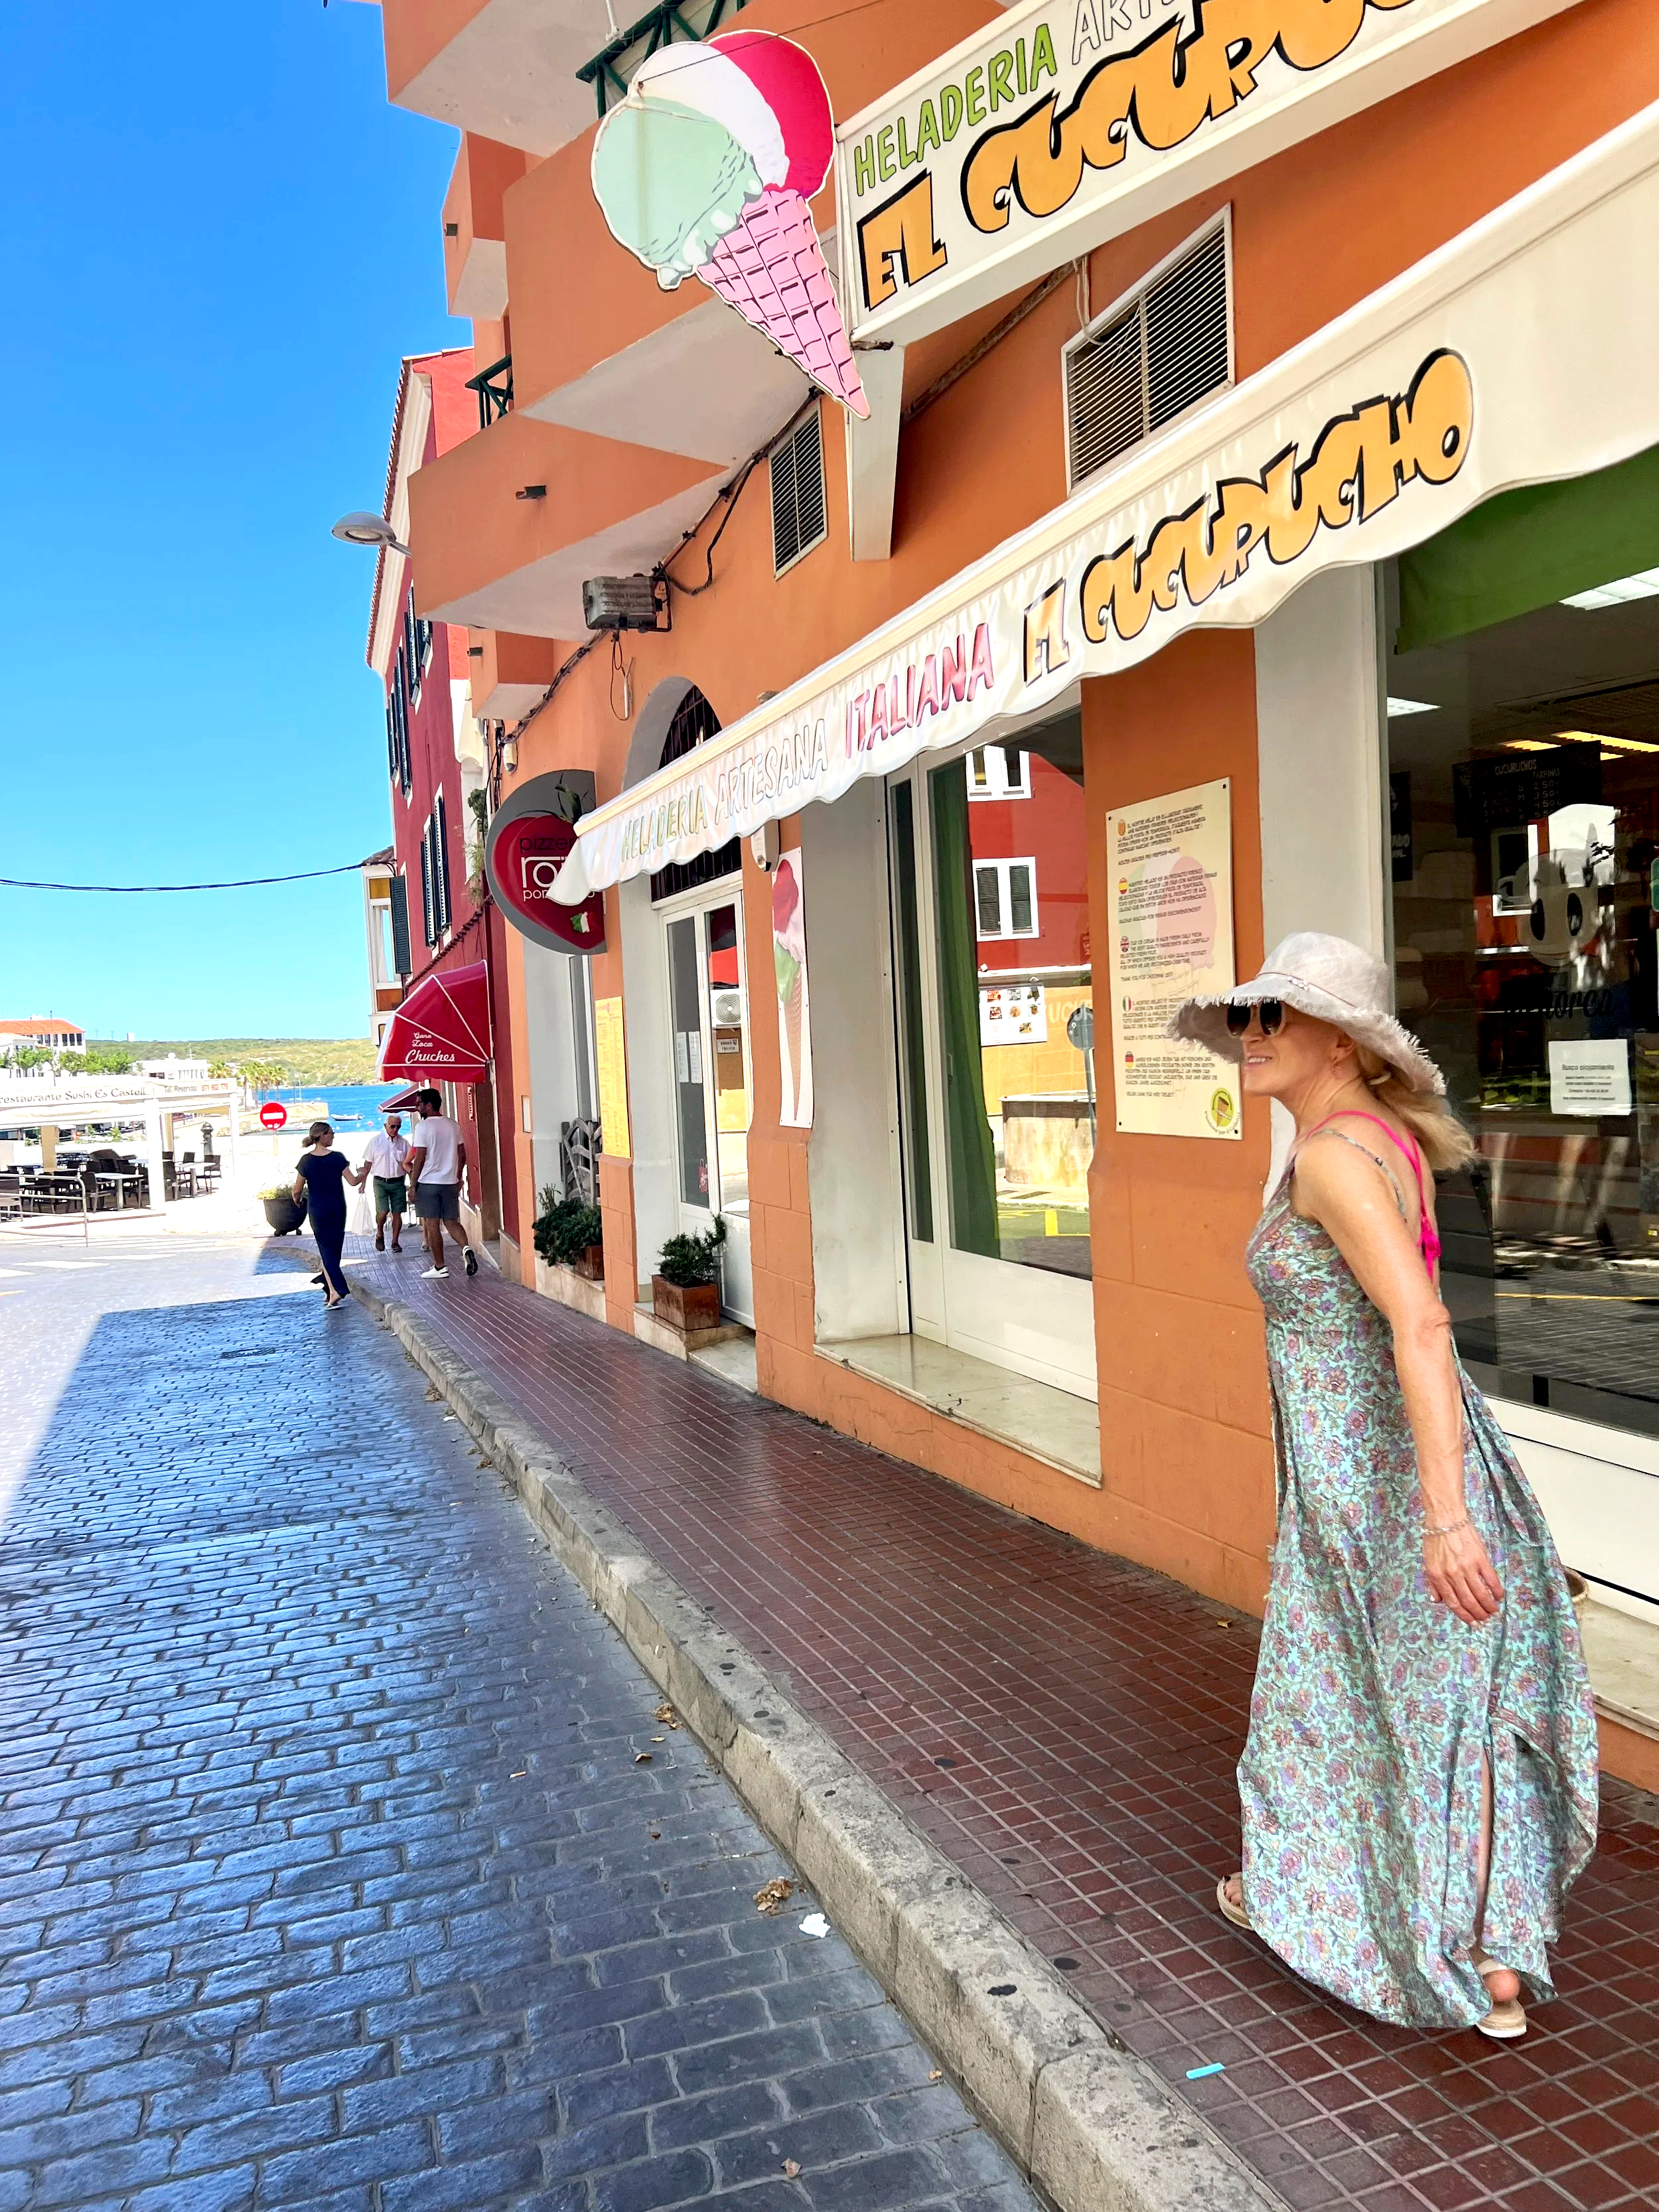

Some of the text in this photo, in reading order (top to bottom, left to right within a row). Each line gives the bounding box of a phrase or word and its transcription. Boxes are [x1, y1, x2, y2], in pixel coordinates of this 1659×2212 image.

[855, 23, 1057, 196] HELADERIA
[857, 170, 948, 311] EL
[1023, 347, 1474, 687] EL CUCURUCHO
[620, 622, 994, 863] HELADERIA ARTESANA ITALIANA
[520, 834, 575, 854] pizzer
[65, 1089, 92, 1101] Sushi
[95, 1089, 108, 1098] Es
[111, 1086, 145, 1097] Castell
[405, 1049, 455, 1064] Chuches
